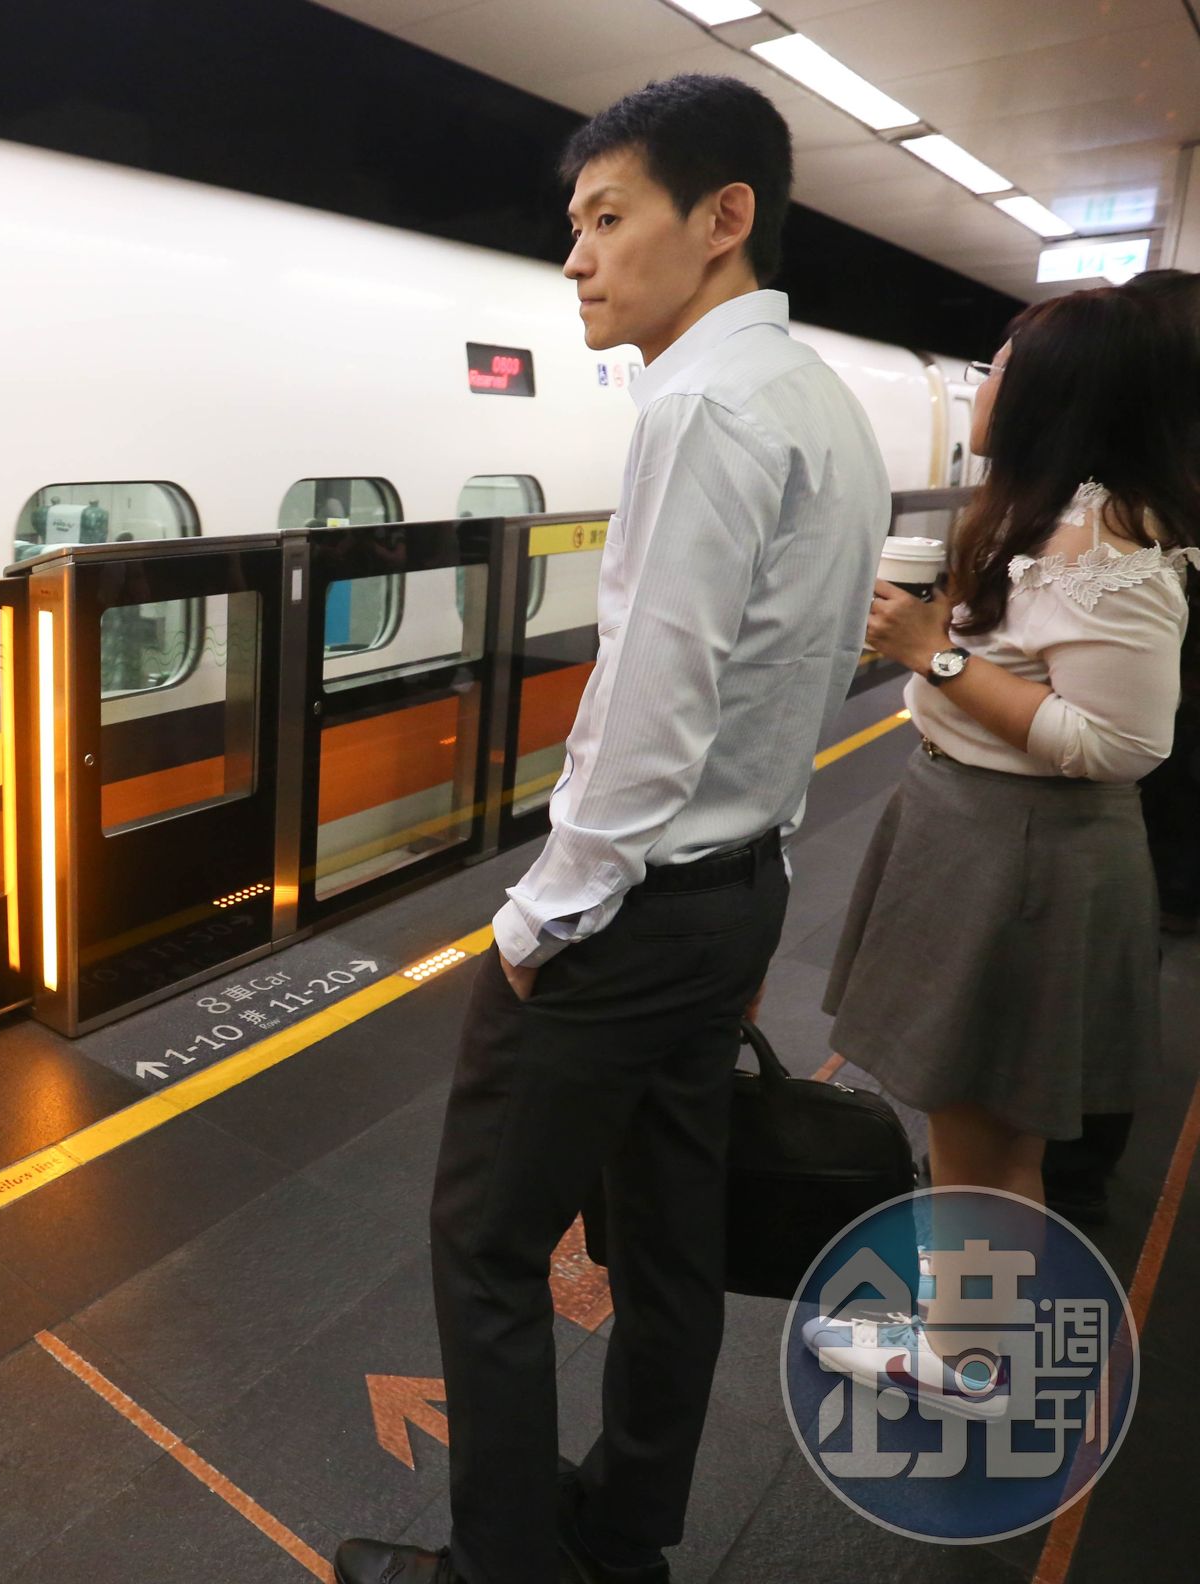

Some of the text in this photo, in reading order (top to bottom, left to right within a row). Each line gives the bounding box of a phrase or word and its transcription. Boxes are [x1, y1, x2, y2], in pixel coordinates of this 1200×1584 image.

[250, 971, 291, 991] Car
[165, 1024, 243, 1065] 1-10
[269, 970, 356, 1013] 11-20
